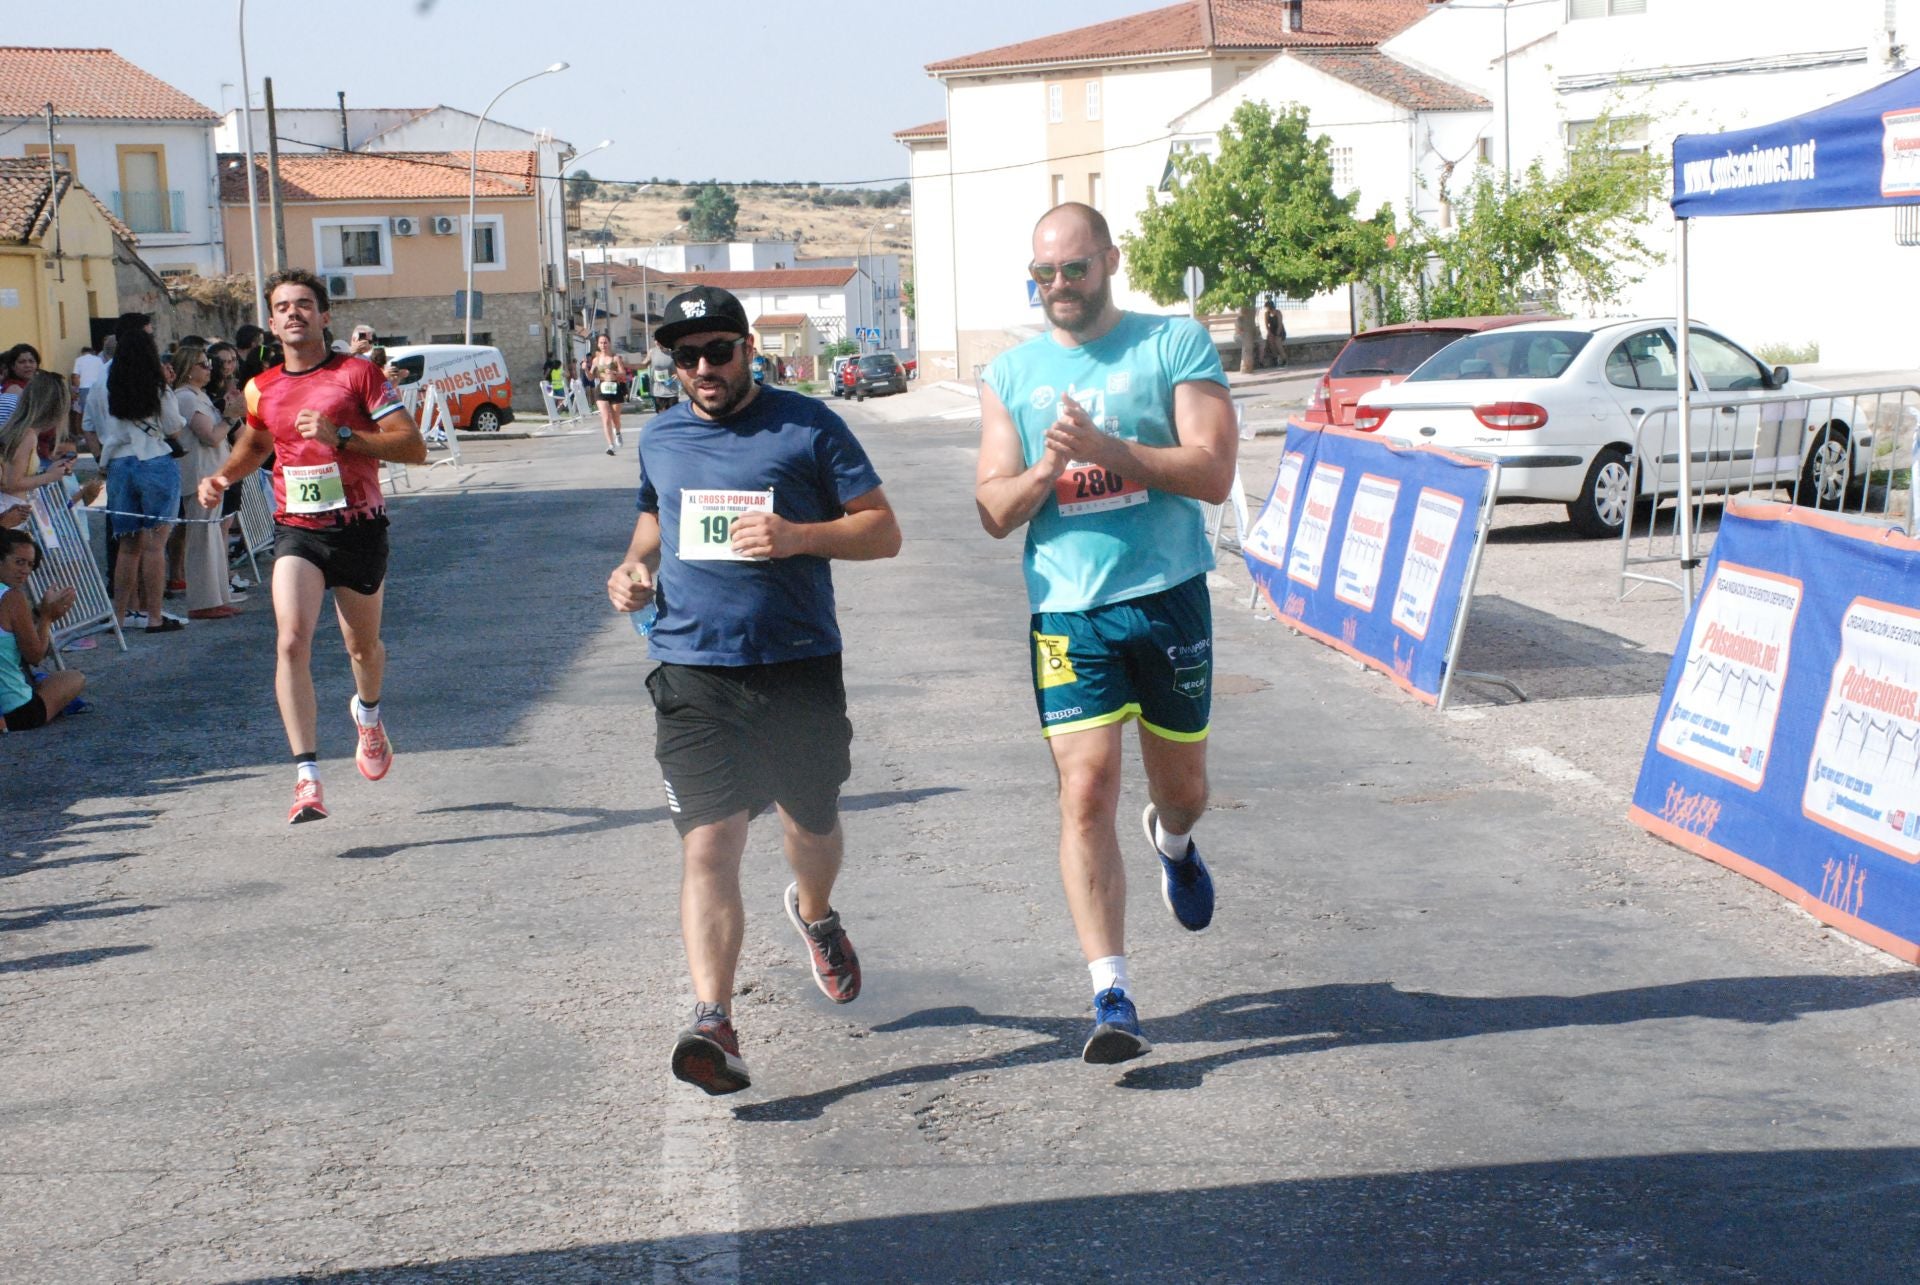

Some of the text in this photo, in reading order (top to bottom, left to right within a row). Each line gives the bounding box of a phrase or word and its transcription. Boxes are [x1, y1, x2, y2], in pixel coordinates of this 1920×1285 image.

[1683, 139, 1816, 195] www.pulsaciones.net
[300, 483, 321, 502] 23
[688, 495, 767, 506] XL CROSS POPULAR
[700, 514, 740, 544] 19
[1699, 620, 1781, 674] Pulsaciones.net
[1044, 706, 1083, 721] Kappa
